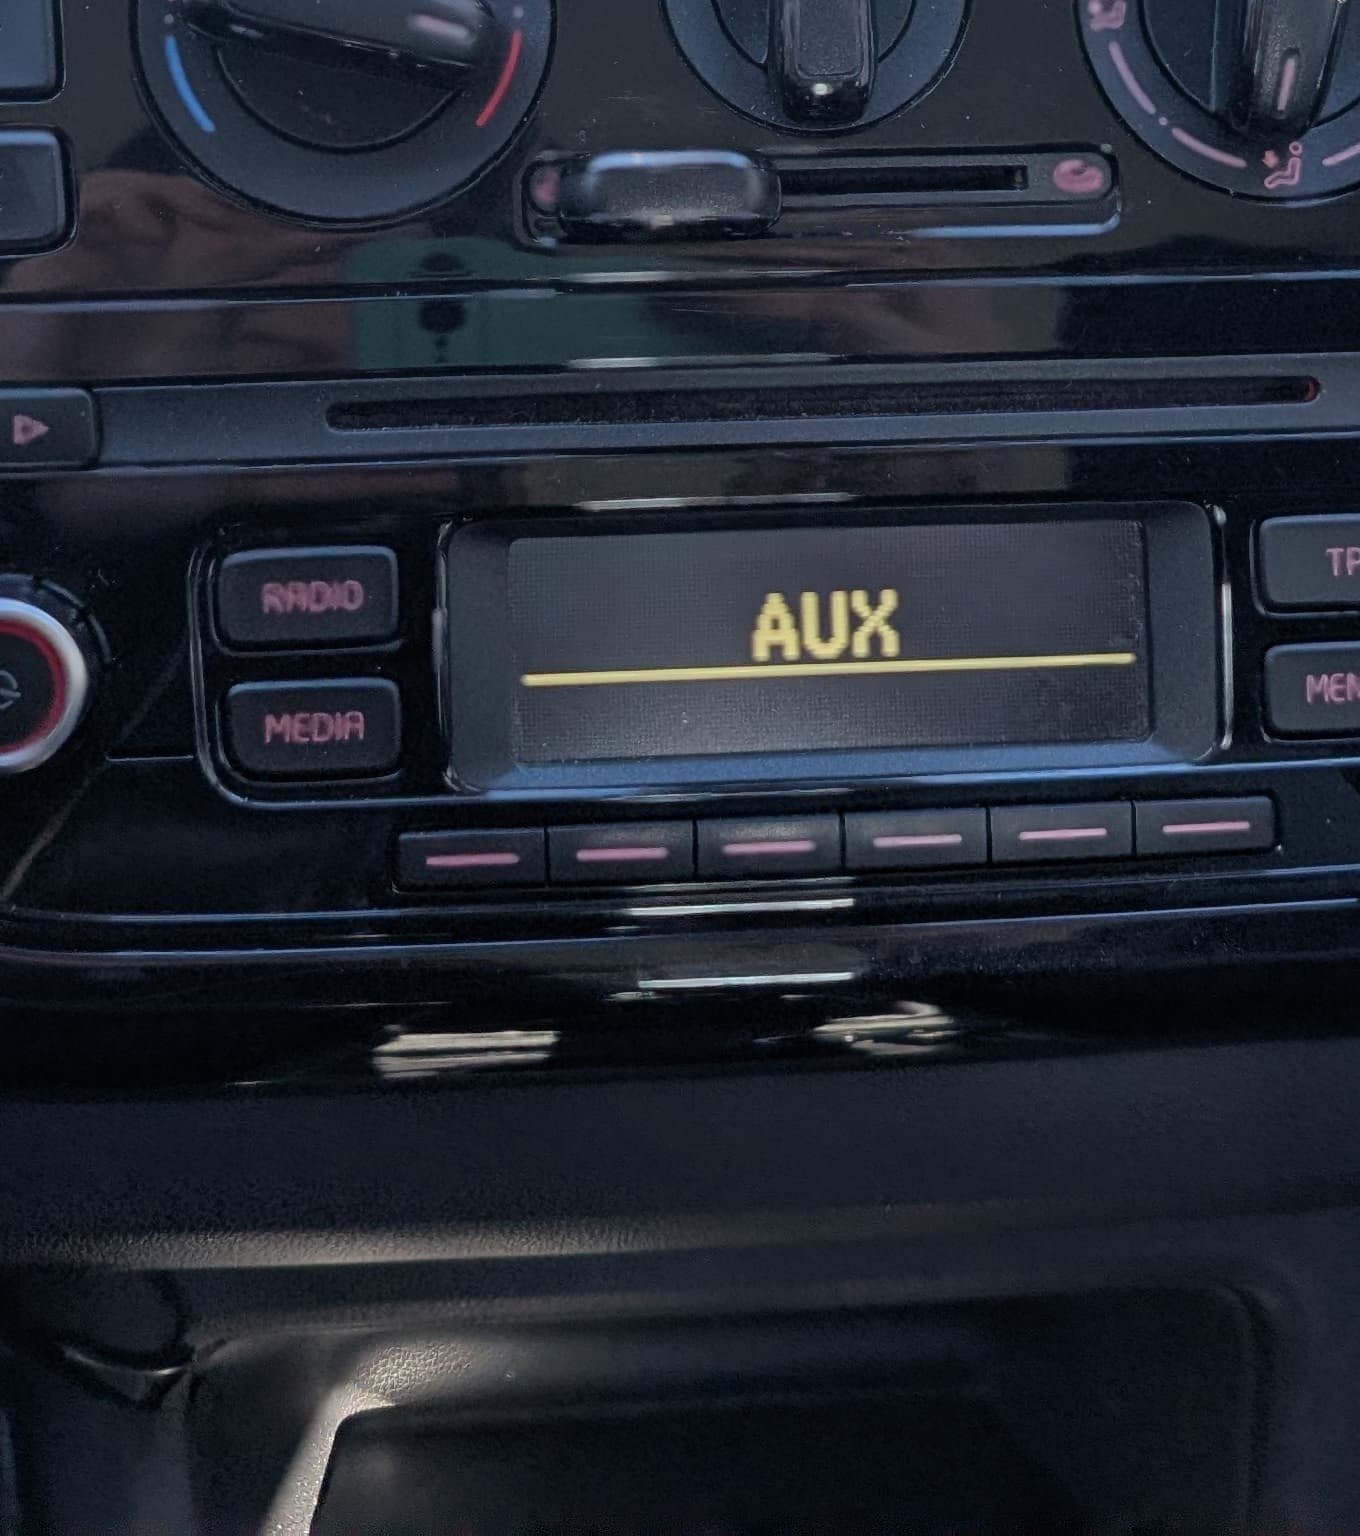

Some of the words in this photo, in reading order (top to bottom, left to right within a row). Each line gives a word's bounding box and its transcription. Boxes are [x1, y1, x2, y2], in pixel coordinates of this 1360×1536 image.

[260, 579, 365, 614] RADIO
[751, 588, 901, 663] AUX
[263, 710, 366, 744] MEDIA
